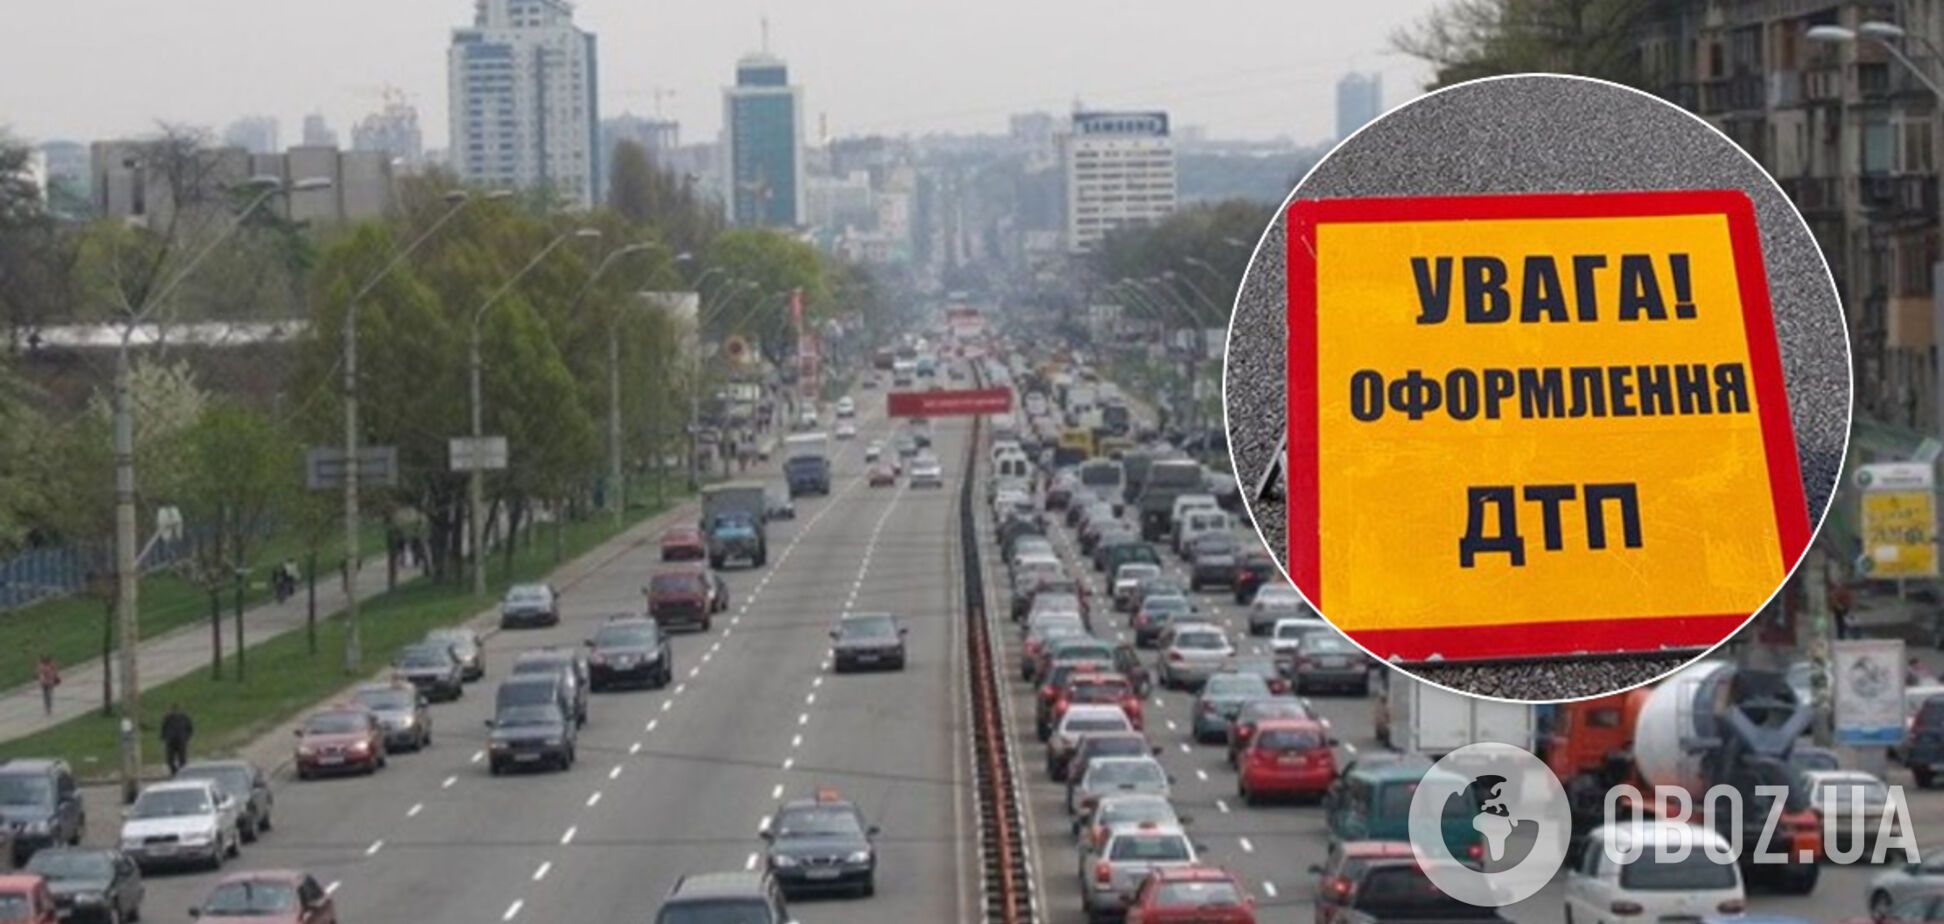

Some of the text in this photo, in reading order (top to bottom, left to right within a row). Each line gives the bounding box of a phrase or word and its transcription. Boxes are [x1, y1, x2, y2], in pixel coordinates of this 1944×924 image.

[1410, 253, 1697, 325] УВАГА!
[1350, 362, 1752, 422] ОФОРМЛЕННЯ
[1459, 482, 1643, 569] ДТП
